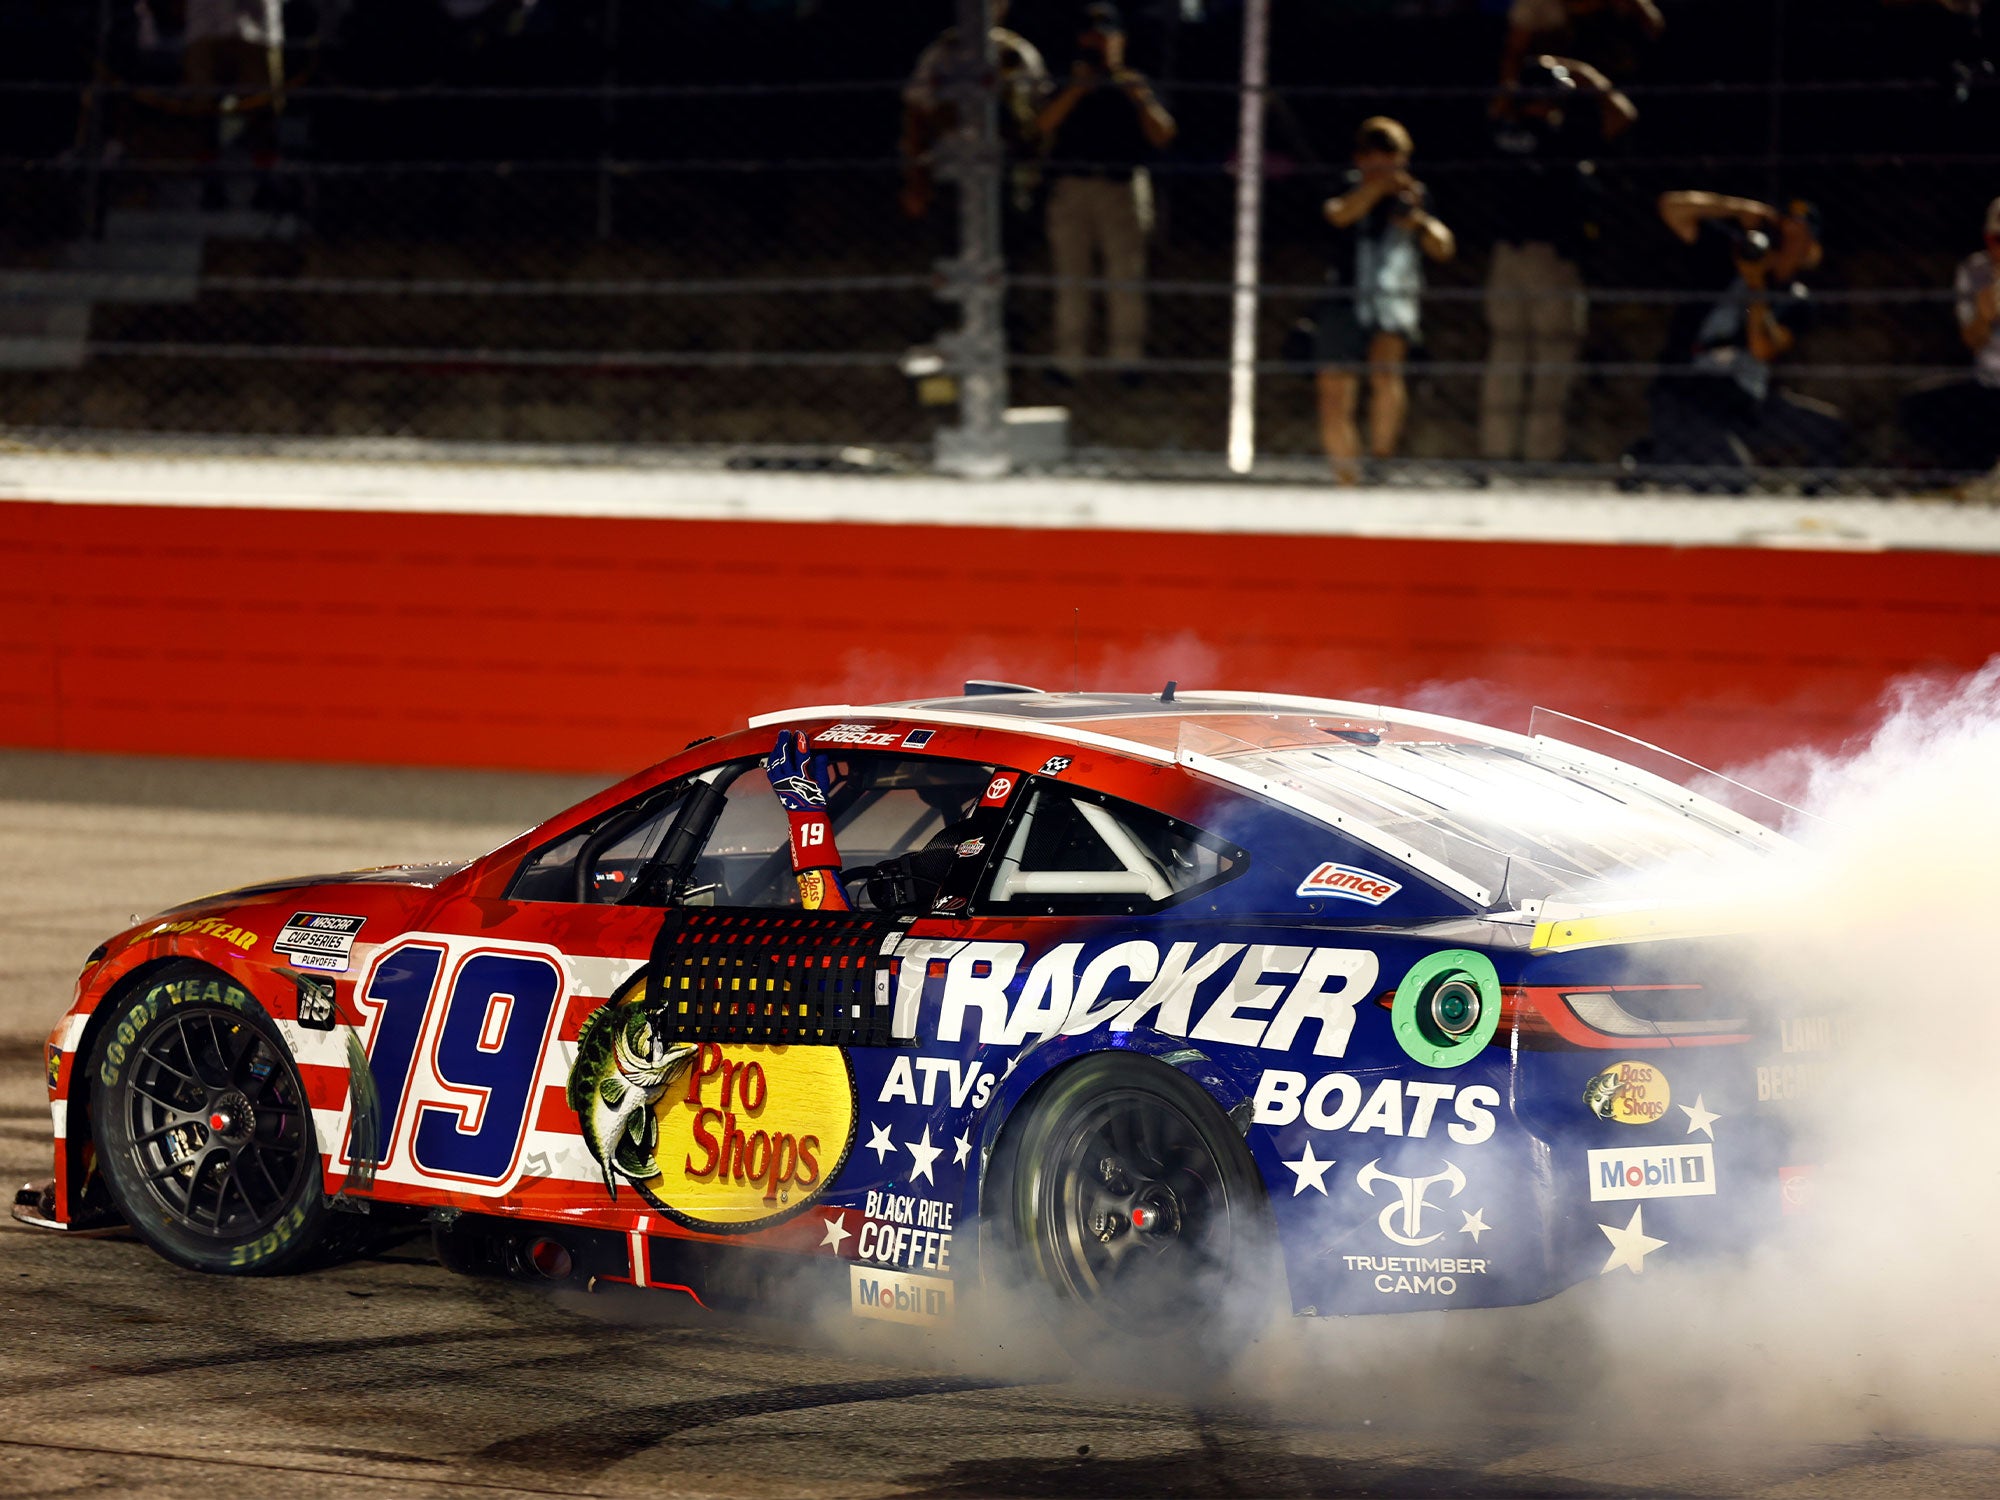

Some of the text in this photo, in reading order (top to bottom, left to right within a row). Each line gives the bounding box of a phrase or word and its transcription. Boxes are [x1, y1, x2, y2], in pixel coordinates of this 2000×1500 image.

[813, 731, 902, 746] BRISCOE
[801, 822, 825, 848] 19
[808, 876, 821, 902] Bass
[1309, 864, 1391, 898] Lance
[310, 915, 354, 931] NASCAR
[287, 931, 344, 949] CUP SERIES
[301, 954, 338, 968] PLAYOFFS
[891, 937, 1380, 1058] TRACKER
[100, 979, 246, 1088] GOODYEAR
[338, 938, 566, 1188] 19
[684, 1042, 767, 1111] Pro
[1619, 1064, 1652, 1083] Bass
[877, 1055, 996, 1110] ATVs
[1620, 1082, 1646, 1099] Pro
[1251, 1068, 1501, 1146] BOATS
[1622, 1097, 1664, 1119] Shops
[684, 1107, 821, 1201] Shops
[1600, 1158, 1676, 1188] Mobil
[864, 1190, 954, 1231] BLACK RIFLE
[857, 1222, 953, 1272] COFFEE
[1342, 1255, 1487, 1274] TRUETIMBER
[859, 1278, 922, 1313] Mobil
[1374, 1274, 1457, 1295] CAMO
